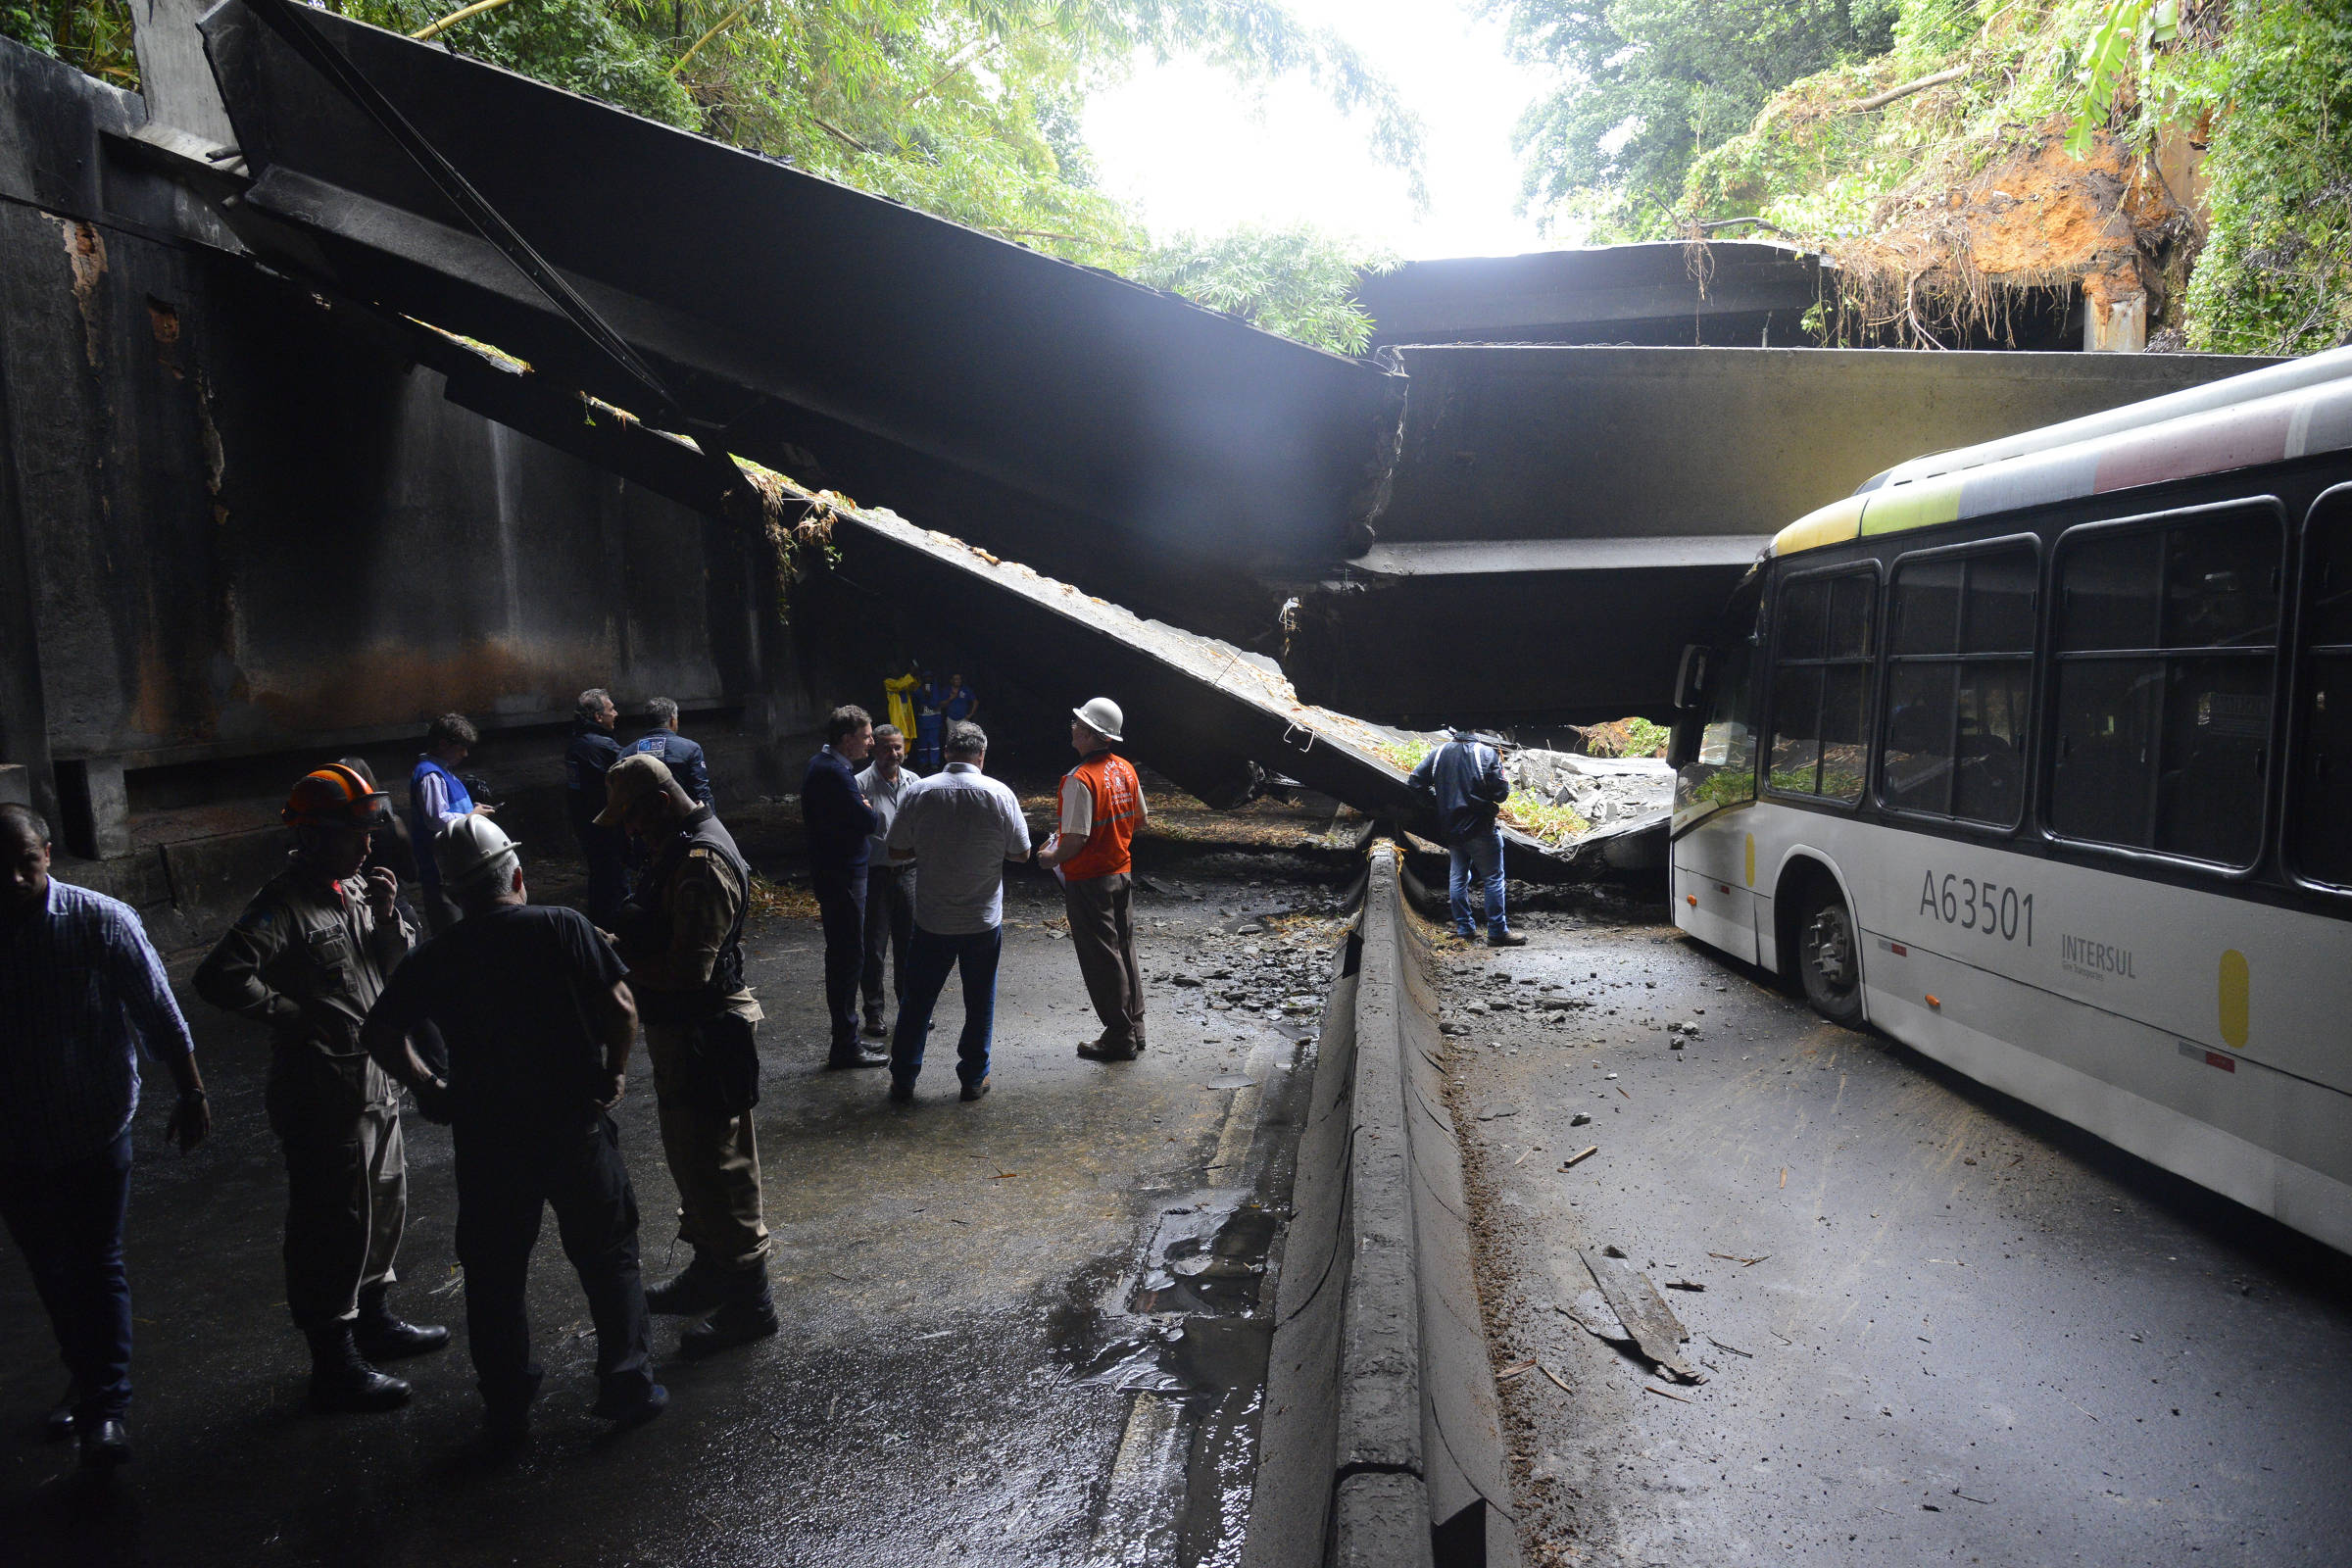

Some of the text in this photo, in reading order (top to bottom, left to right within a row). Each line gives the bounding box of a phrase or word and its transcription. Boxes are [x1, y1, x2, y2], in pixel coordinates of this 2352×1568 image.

[1104, 760, 1117, 789] DEFESA
[1920, 869, 2033, 947] A63501
[2062, 934, 2136, 979] INTERSUL
